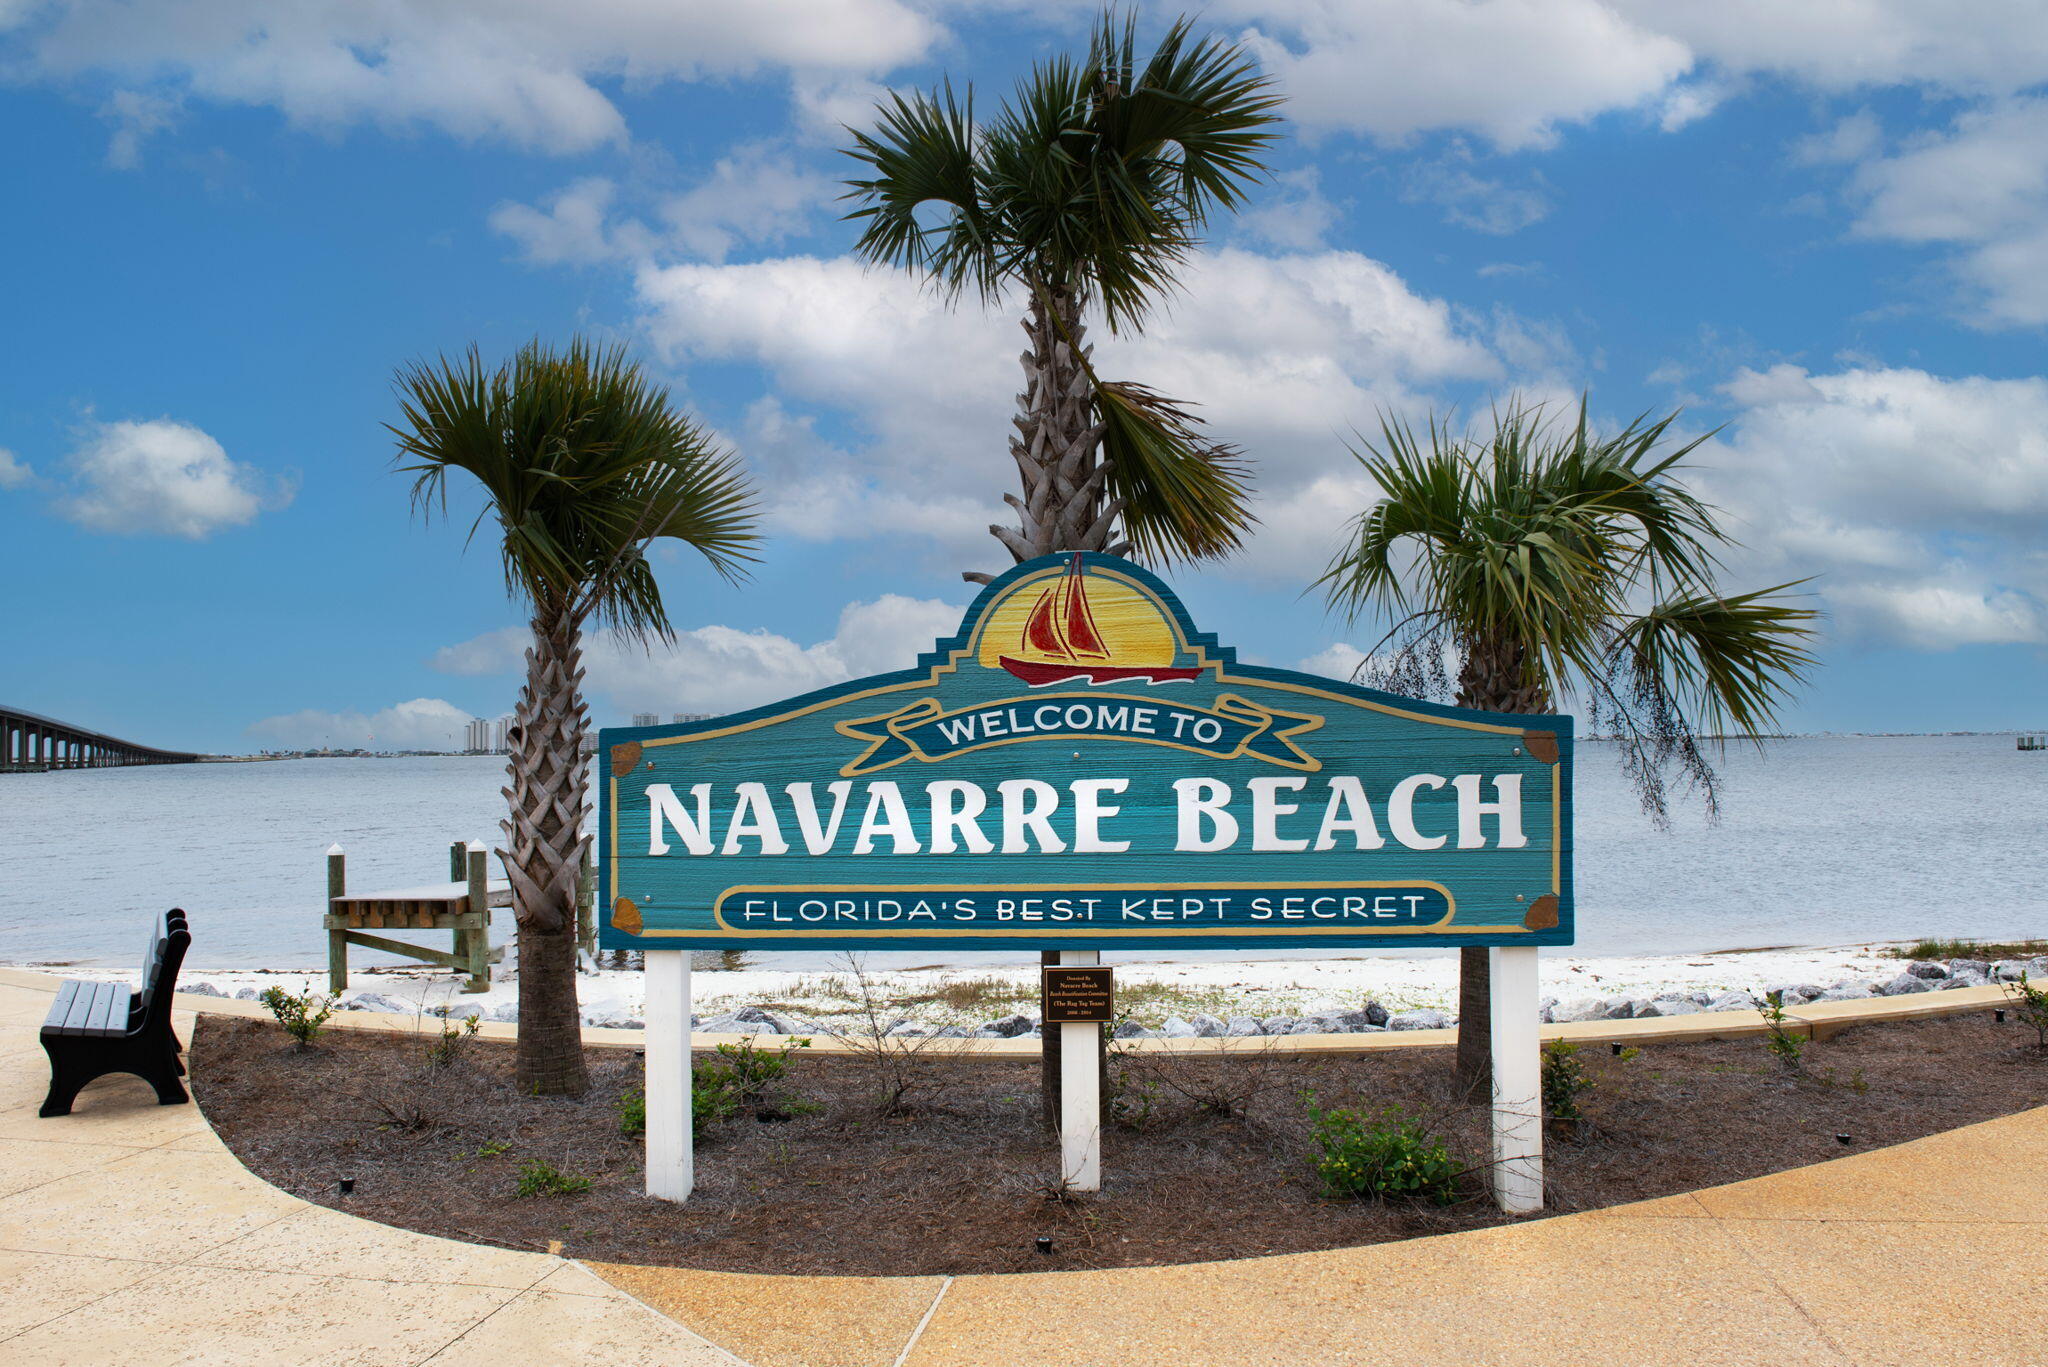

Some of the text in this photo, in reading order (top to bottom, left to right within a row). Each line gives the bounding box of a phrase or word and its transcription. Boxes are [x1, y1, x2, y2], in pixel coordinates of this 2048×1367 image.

[937, 704, 1223, 745] WELCOME TO
[644, 773, 1528, 856] NAVARRE BEACH
[743, 896, 1425, 922] FLORIDA'S BEST KEPT SECRET
